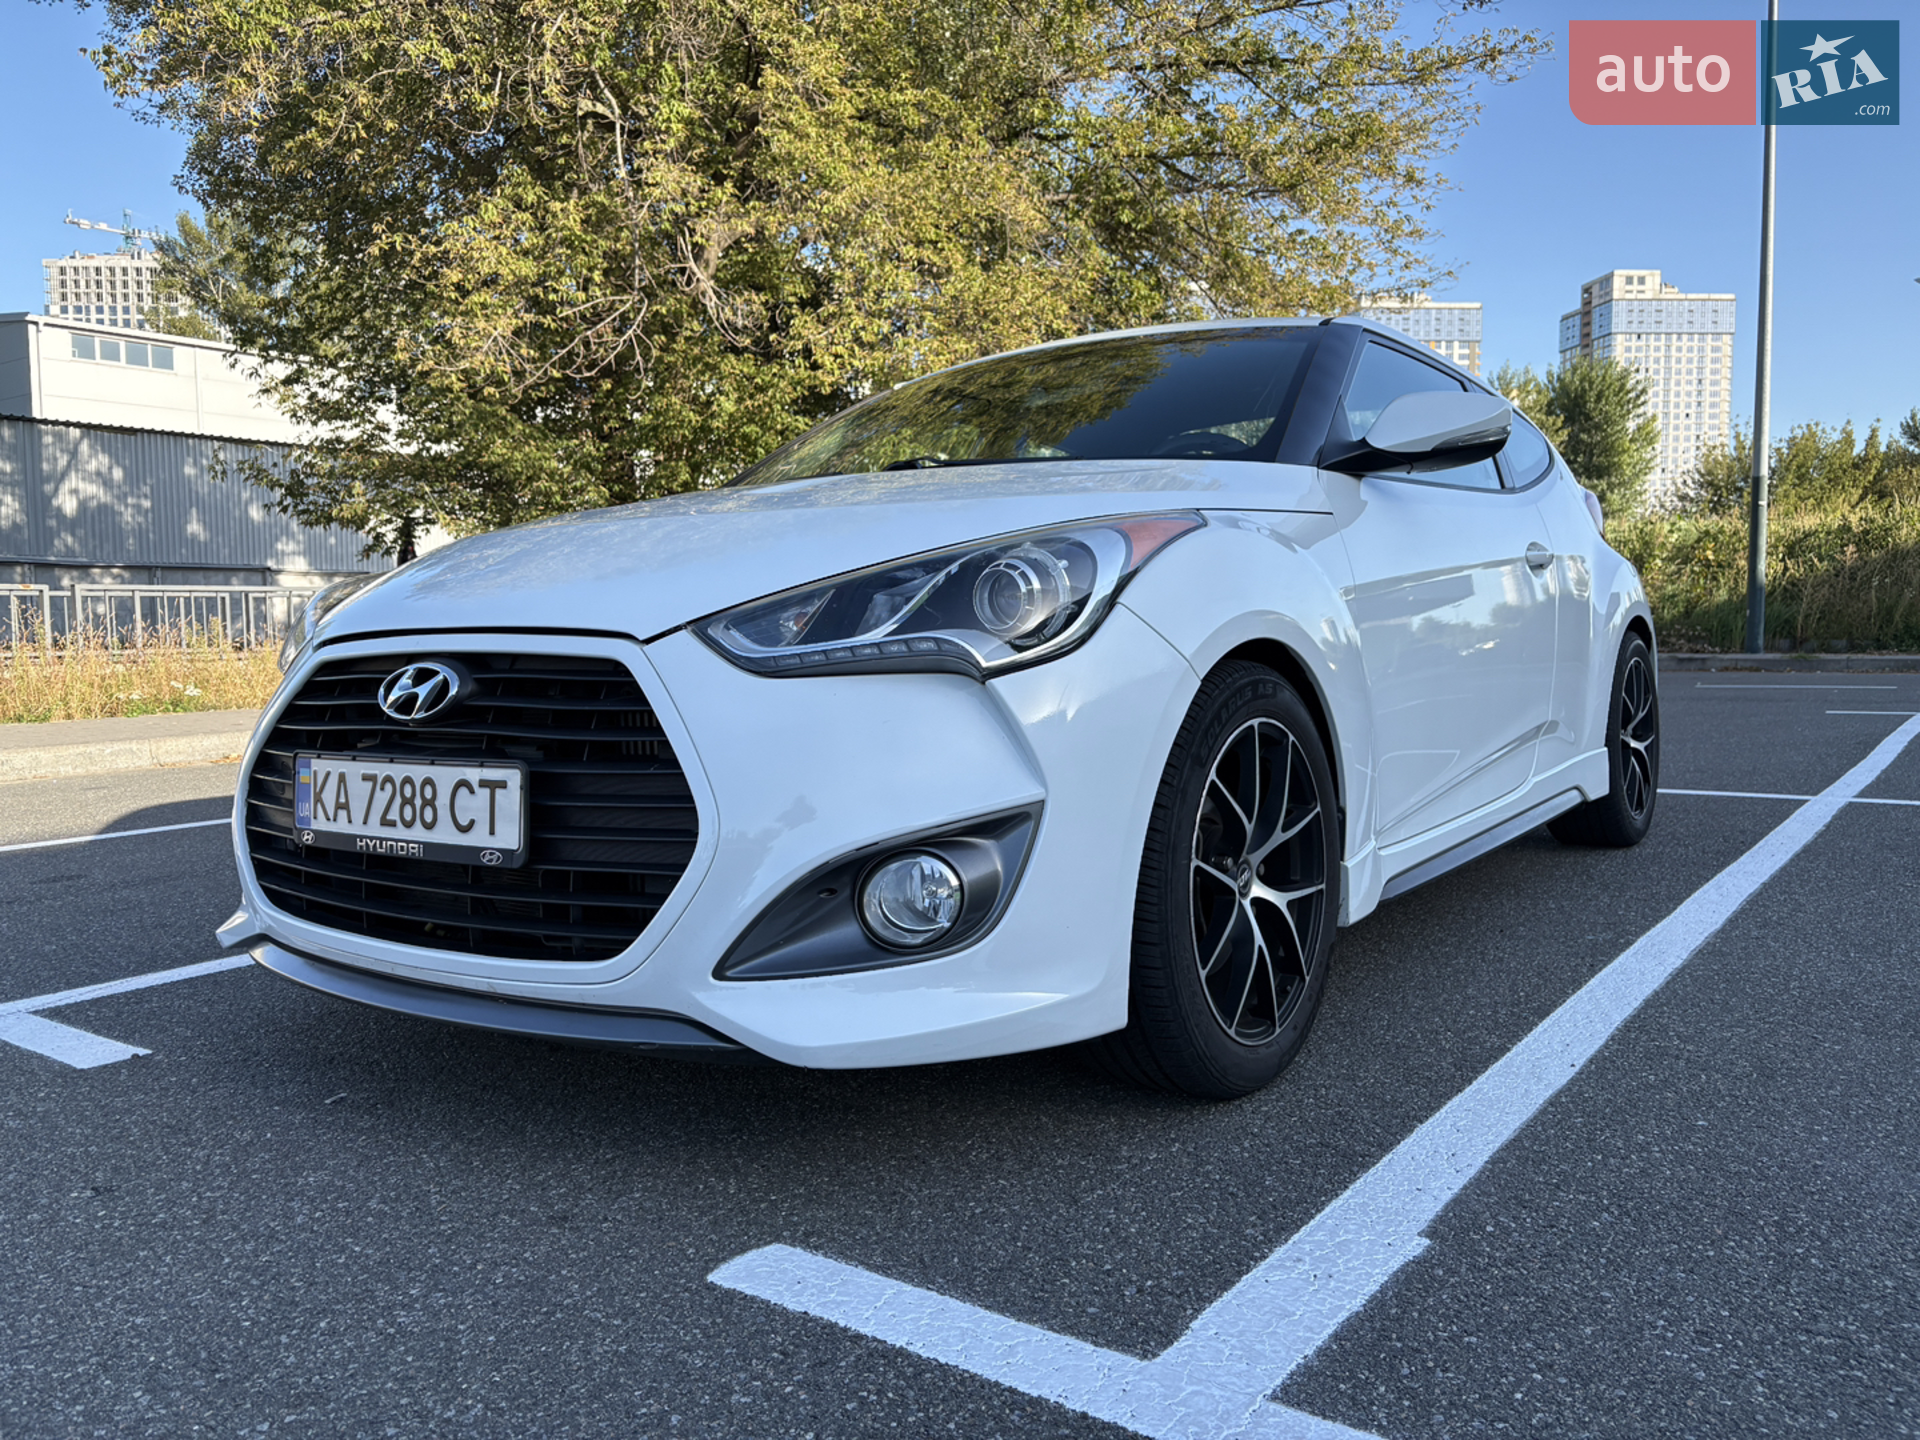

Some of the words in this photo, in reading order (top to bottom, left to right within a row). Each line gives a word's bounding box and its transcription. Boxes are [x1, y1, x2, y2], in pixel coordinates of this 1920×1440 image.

[298, 802, 311, 817] UA
[312, 768, 353, 824] KA
[361, 772, 438, 830] 7288
[449, 778, 508, 836] CT
[356, 838, 424, 857] HYUNDAI
